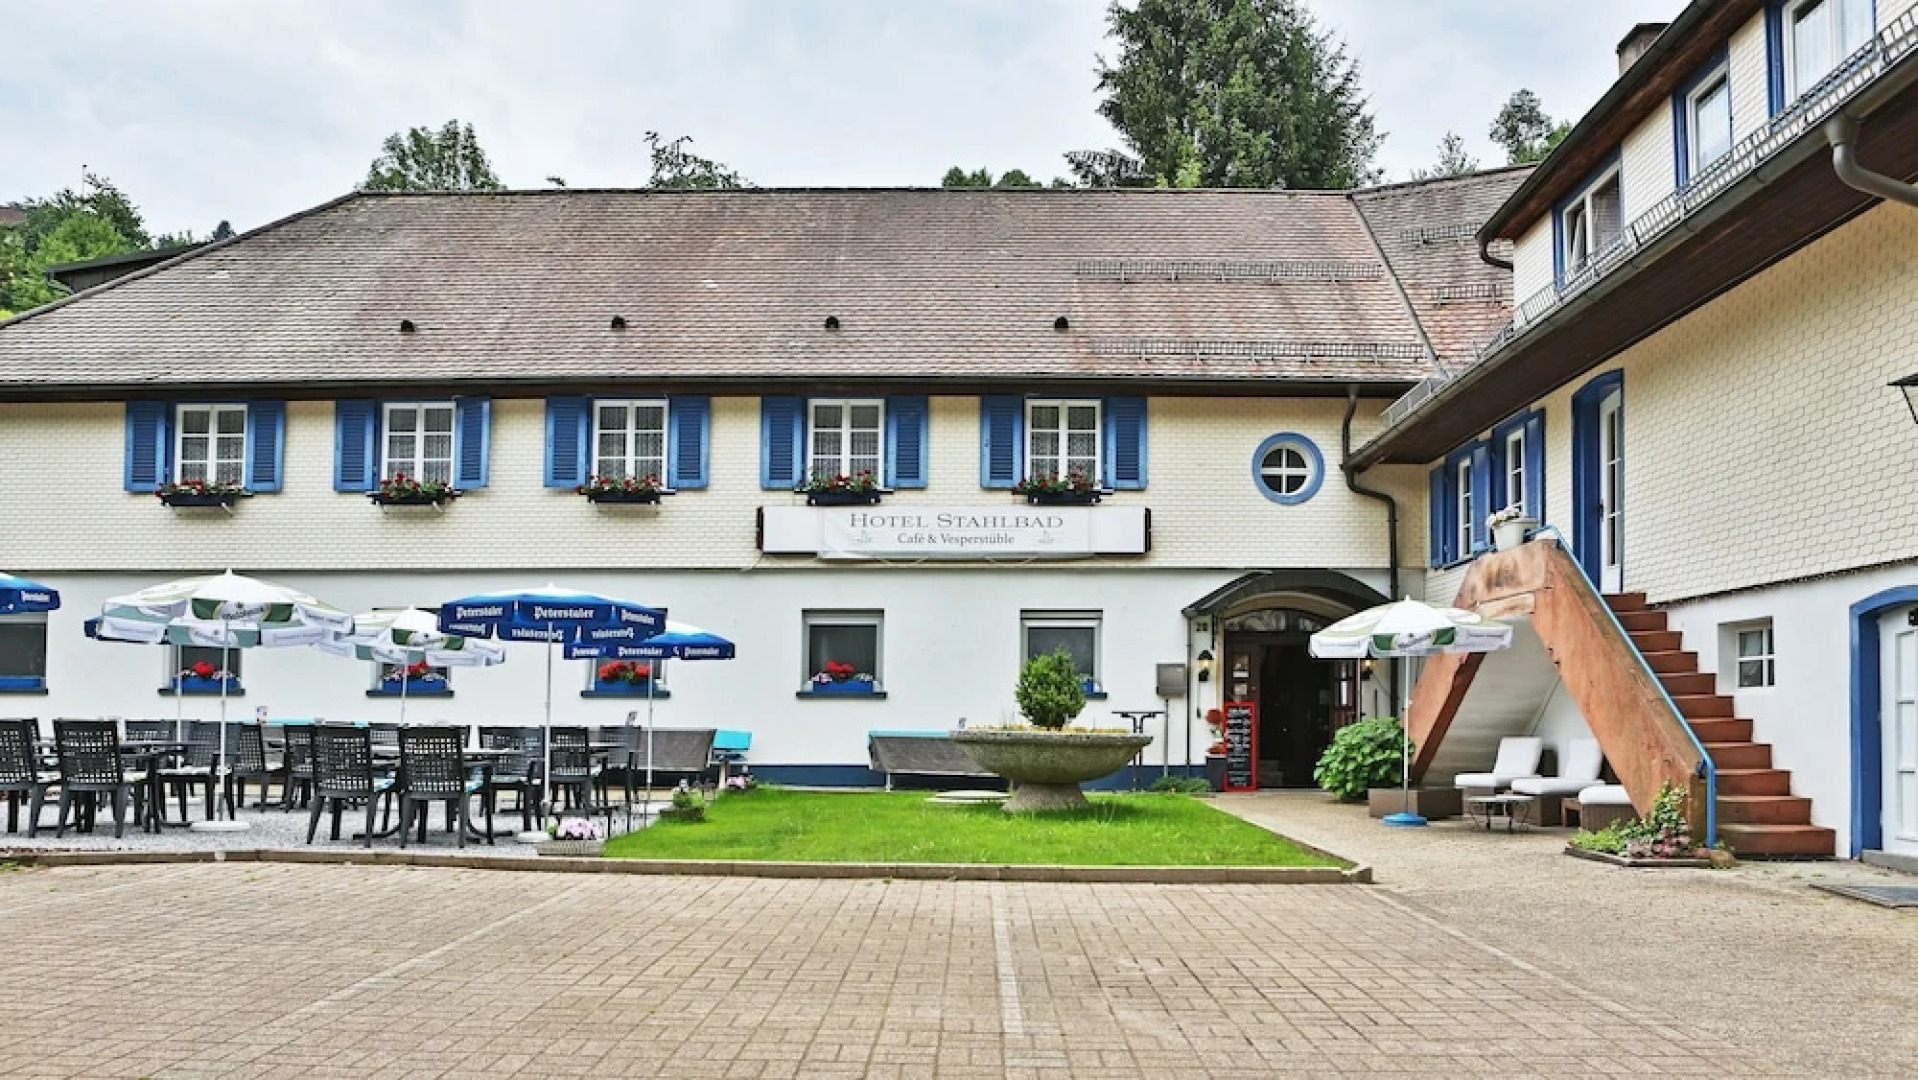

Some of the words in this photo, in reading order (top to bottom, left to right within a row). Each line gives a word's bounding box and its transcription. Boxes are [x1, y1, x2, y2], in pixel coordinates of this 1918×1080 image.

[851, 513, 928, 528] HOTEL
[937, 513, 1063, 528] STAHLBAD
[898, 532, 925, 543] Café
[928, 533, 936, 543] &
[940, 532, 1015, 547] Vesperstüble
[456, 606, 503, 619] Peterstaler
[533, 606, 594, 620] Peterstaler
